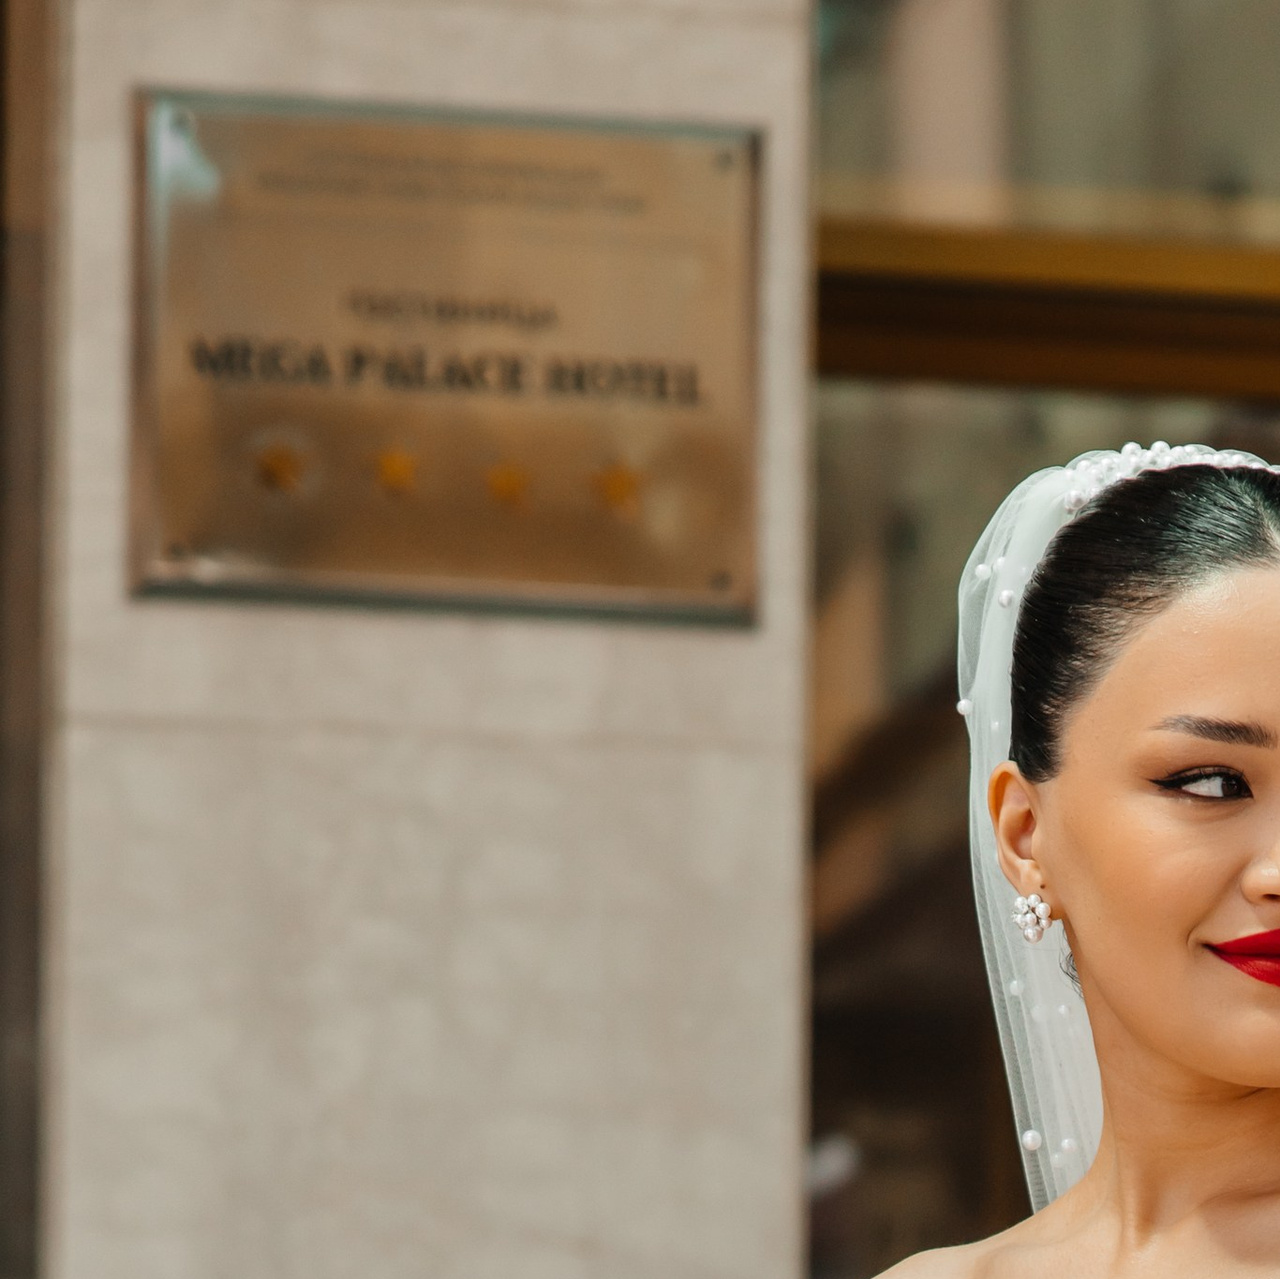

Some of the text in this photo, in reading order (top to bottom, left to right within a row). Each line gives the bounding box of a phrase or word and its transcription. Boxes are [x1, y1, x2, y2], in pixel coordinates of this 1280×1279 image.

[190, 336, 703, 404] MEGA PALACE HOTEL
